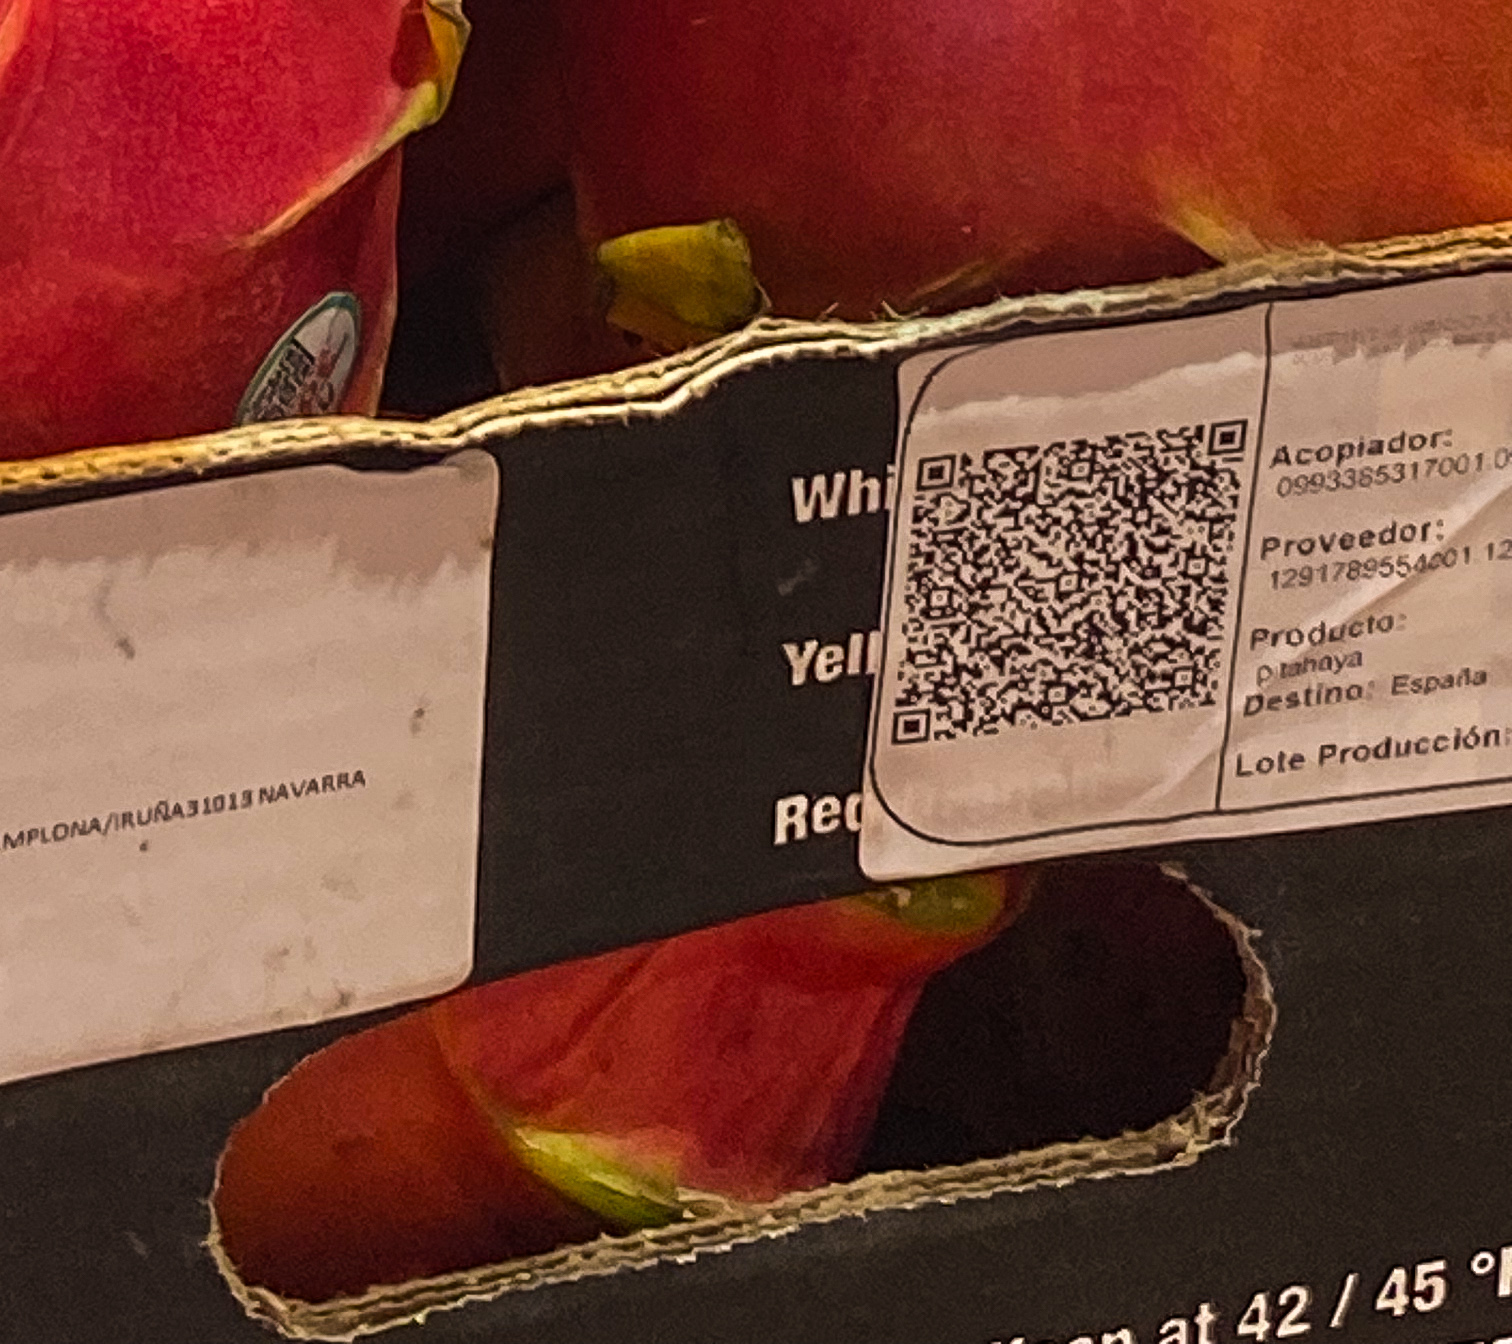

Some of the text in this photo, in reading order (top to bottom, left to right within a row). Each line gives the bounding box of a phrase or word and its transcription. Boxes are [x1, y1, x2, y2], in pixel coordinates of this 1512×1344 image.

[1269, 428, 1453, 469] Acopiador:
[1261, 519, 1444, 560] Proveedor:
[1250, 613, 1407, 651] Producto:
[781, 631, 880, 685] Yell
[1243, 667, 1487, 717] Destino: España
[1235, 750, 1306, 778] Lote
[258, 769, 367, 807] NAVARRA
[1237, 1285, 1312, 1342] 42
[1328, 1273, 1360, 1329] /
[1375, 1259, 1447, 1317] 45
